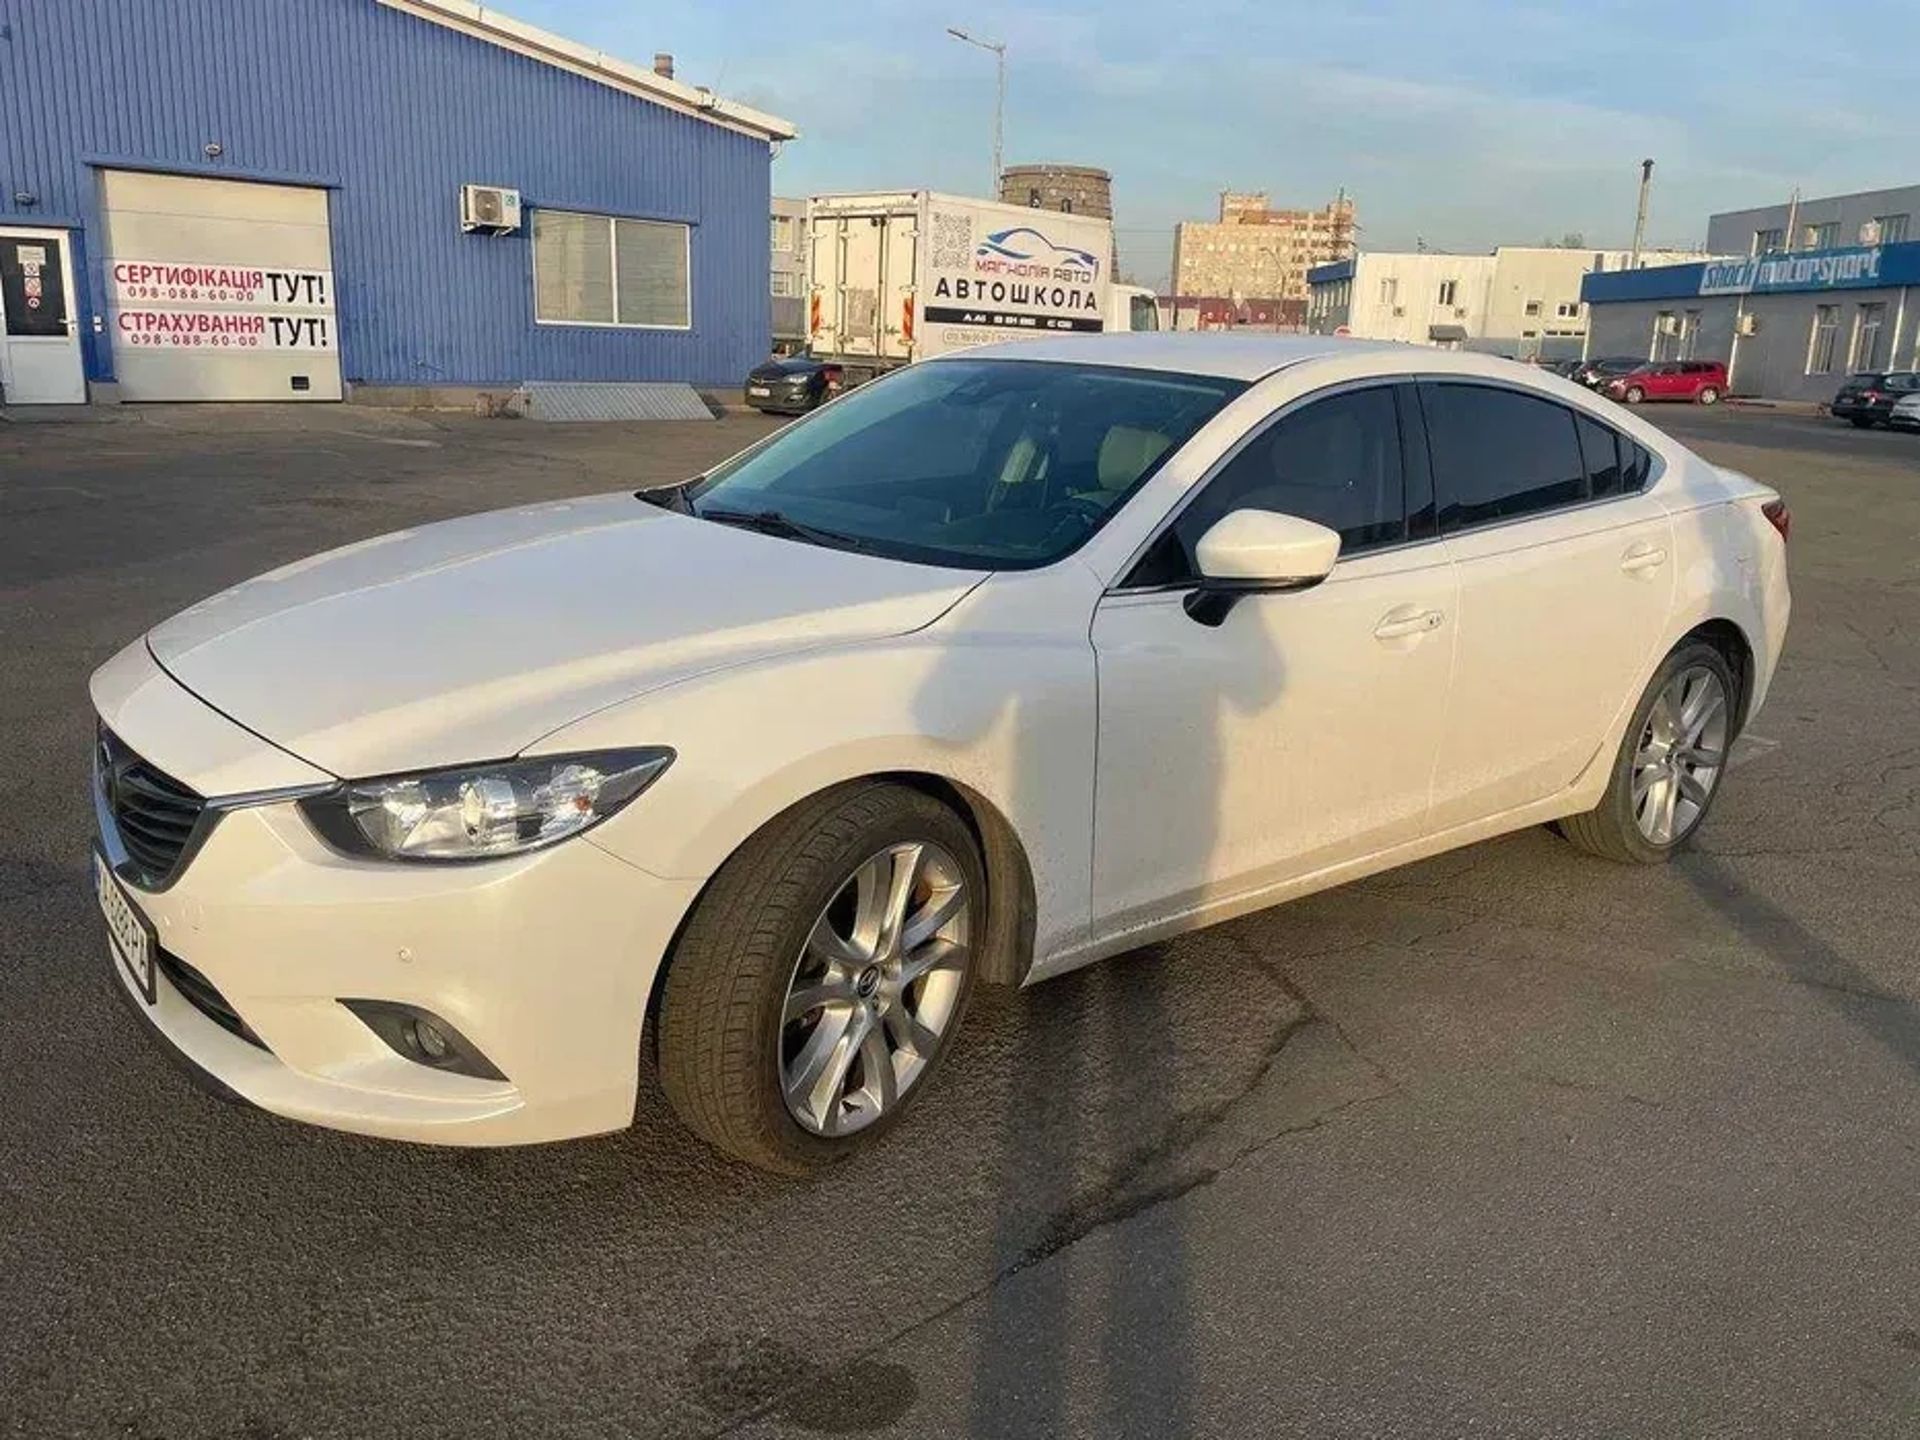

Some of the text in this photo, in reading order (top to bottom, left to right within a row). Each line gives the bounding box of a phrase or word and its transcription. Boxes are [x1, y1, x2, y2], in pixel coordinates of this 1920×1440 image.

[114, 264, 326, 304] СЕРТИФІКАЦІЯ ТУТ!
[975, 261, 1091, 284] МАГНОЛІЯ АВТО
[127, 285, 256, 302] 098-088-60-00
[935, 277, 1098, 310] АВТОШКОЛА
[118, 312, 328, 346] СТРАХУВАННЯ ТУТ!
[131, 333, 258, 346] 098-088-60-00
